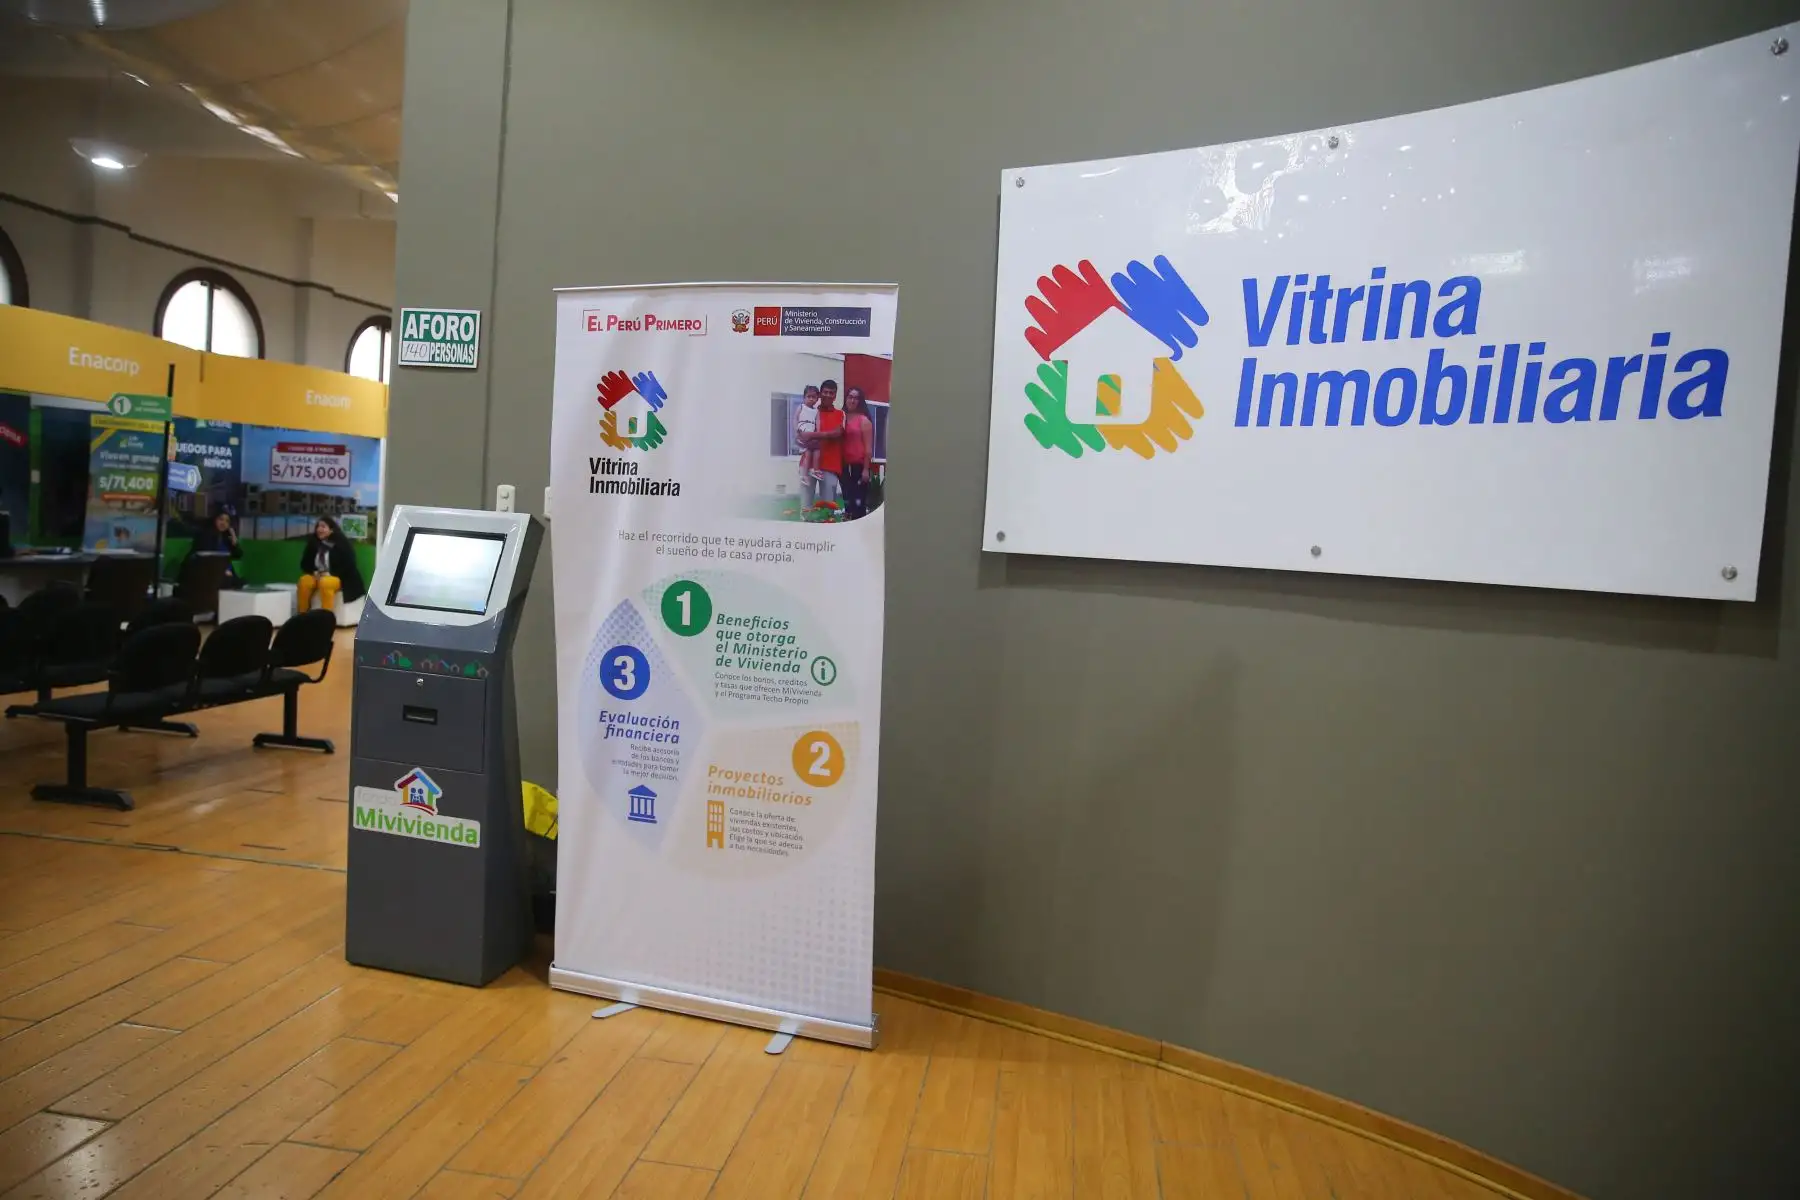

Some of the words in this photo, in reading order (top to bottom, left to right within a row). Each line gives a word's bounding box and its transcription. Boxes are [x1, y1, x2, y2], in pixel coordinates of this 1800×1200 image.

[1242, 266, 1484, 349] Vitrina
[403, 313, 475, 341] AFORO
[756, 315, 778, 326] PERÚ
[784, 317, 793, 325] de
[794, 317, 824, 326] Vivienda,
[824, 317, 867, 325] Construcción
[404, 343, 428, 358] 140
[430, 342, 475, 364] PERSONAS
[68, 346, 140, 376] Enacorp
[1233, 331, 1731, 430] Inmobiliaria
[176, 441, 208, 455] UEGOS
[207, 445, 233, 457] PARA
[203, 456, 233, 470] NIÑOS
[292, 456, 312, 464] CASA
[589, 457, 638, 476] Vitrina
[272, 464, 347, 481] S/175,000
[589, 476, 681, 497] Inmobiliaria
[618, 530, 636, 541] Haz
[638, 530, 649, 541] el
[651, 532, 699, 544] recorrido
[701, 535, 722, 547] que
[724, 536, 735, 546] te
[737, 537, 782, 550] ayudará
[785, 541, 792, 549] a
[794, 540, 836, 554] cumplir
[655, 545, 665, 555] el
[667, 545, 699, 557] sueño
[701, 546, 715, 558] de
[717, 548, 727, 558] la
[729, 551, 753, 560] casa
[755, 551, 796, 563] propia.
[676, 590, 691, 627] 1
[716, 613, 790, 630] Beneficios
[716, 629, 741, 642] que
[746, 631, 796, 647] otorga
[716, 641, 729, 653] el
[733, 642, 808, 660] Ministerio
[612, 655, 636, 691] 3
[715, 655, 732, 667] de
[737, 657, 801, 674] Vivienda
[714, 672, 740, 680] Conoce
[741, 674, 752, 682] los
[777, 677, 808, 687] créditos
[720, 682, 738, 690] tasas
[739, 684, 753, 692] que
[754, 685, 781, 694] ofrecen
[728, 691, 761, 701] Programa
[763, 694, 783, 703] Techo
[784, 696, 809, 706] Propio
[598, 710, 680, 730] Evaluación
[603, 723, 680, 744] financiera
[640, 753, 649, 761] los
[651, 755, 674, 764] bancos
[643, 763, 658, 771] para
[808, 741, 831, 777] 2
[630, 770, 649, 778] mejor
[708, 764, 784, 786] Proyectos
[707, 781, 813, 806] inmobiliarios
[729, 807, 755, 817] Conoce
[756, 810, 763, 818] la
[764, 811, 785, 821] oferta
[786, 814, 796, 823] de
[729, 817, 761, 827] viviendas
[356, 806, 479, 845] Mivivienda
[729, 825, 741, 833] sus
[741, 827, 763, 836] costos
[729, 833, 745, 843] Elige
[754, 837, 767, 846] que
[769, 839, 777, 847] se
[778, 839, 803, 850] adecua
